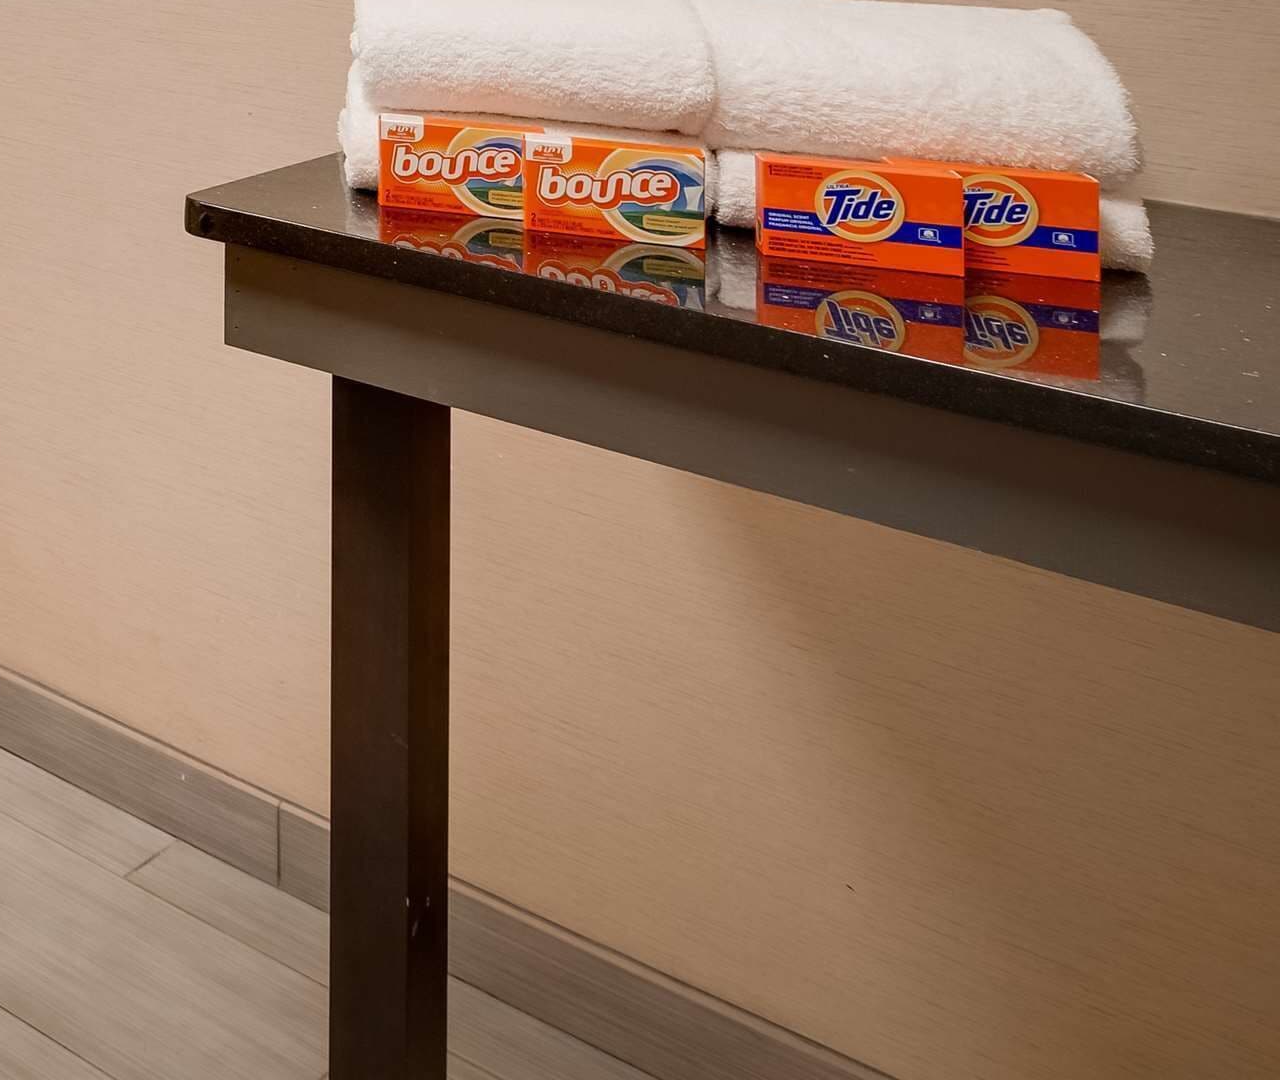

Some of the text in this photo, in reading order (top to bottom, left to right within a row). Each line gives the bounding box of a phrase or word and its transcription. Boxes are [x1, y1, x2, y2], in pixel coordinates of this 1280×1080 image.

[393, 146, 516, 180] bounce
[540, 168, 672, 204] bounce
[824, 189, 896, 226] Tide
[964, 192, 1030, 228] Tide
